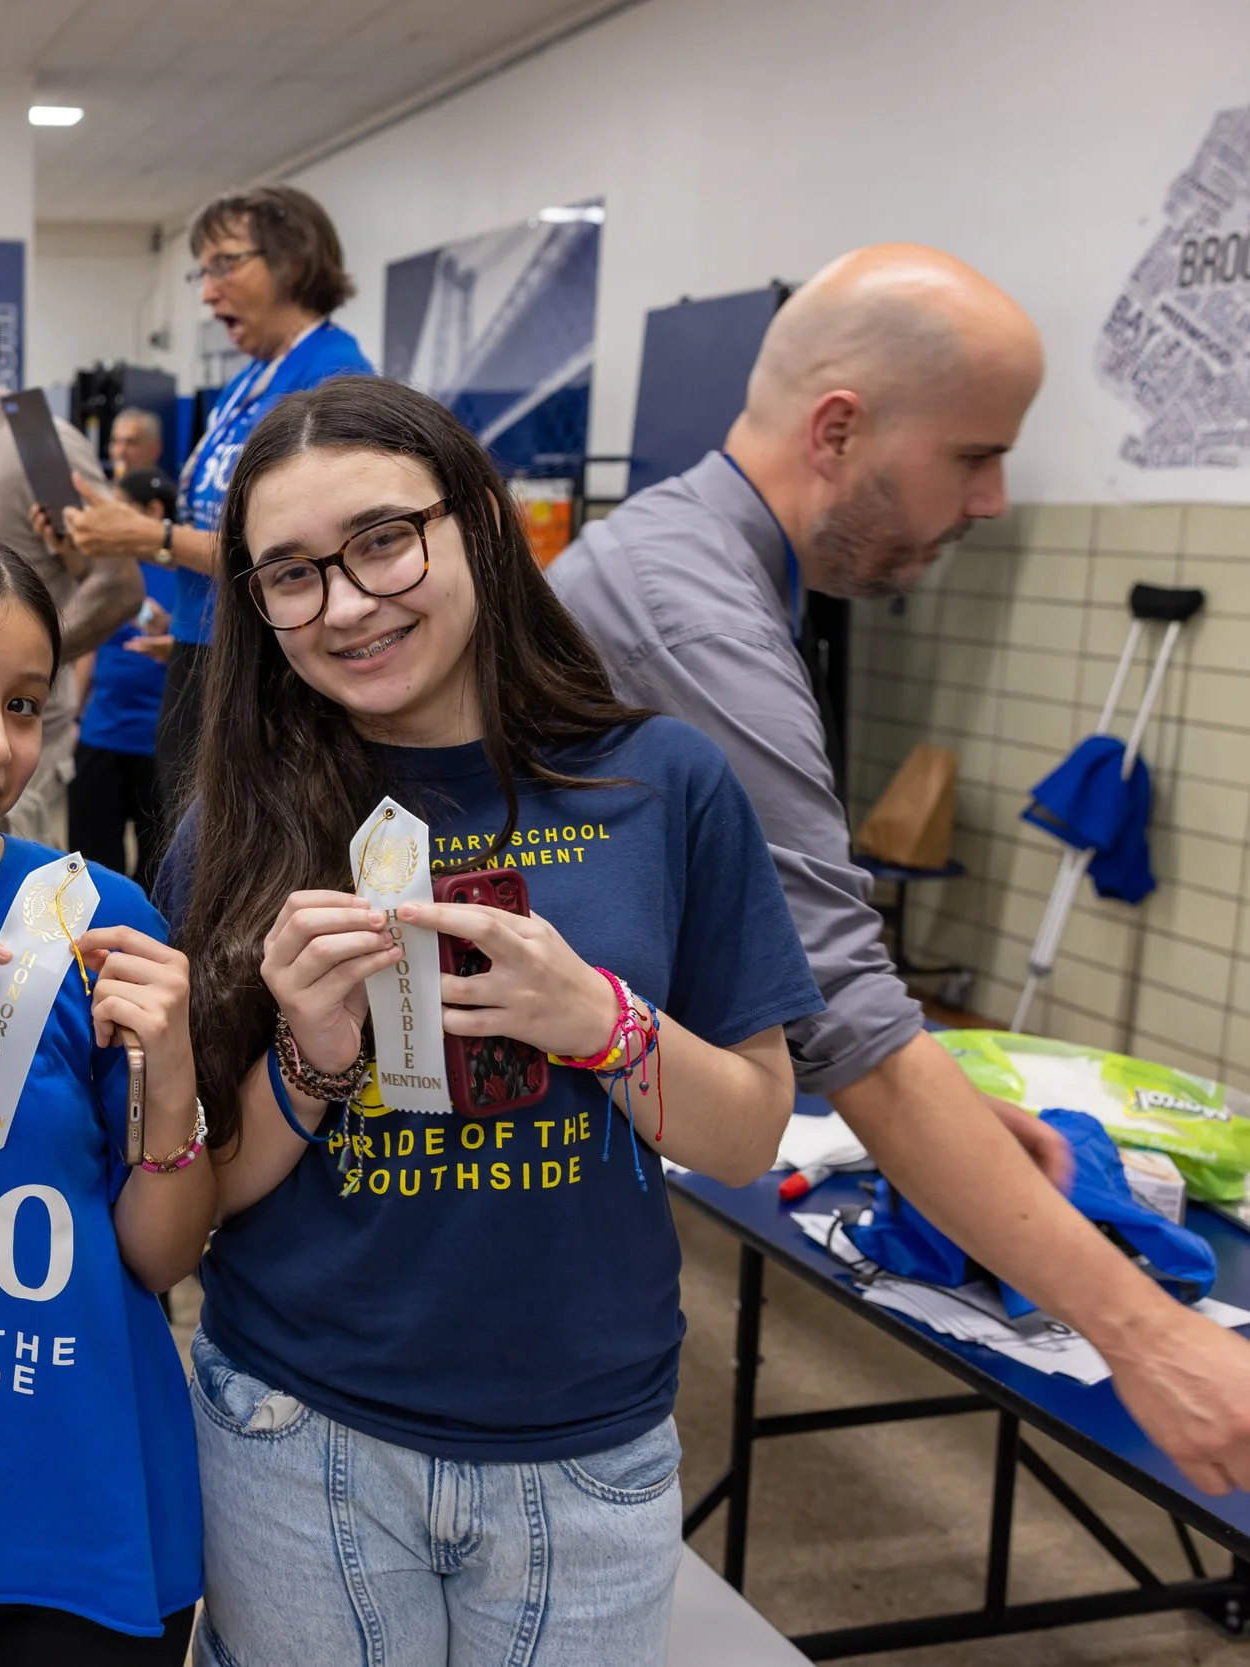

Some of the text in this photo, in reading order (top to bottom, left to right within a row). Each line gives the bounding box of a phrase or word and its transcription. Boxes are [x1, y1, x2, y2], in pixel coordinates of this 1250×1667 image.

[427, 824, 610, 853] TARY SCHOOL
[381, 1072, 442, 1090] MENTION
[328, 1112, 591, 1158] PRIDE OF THE
[343, 1155, 582, 1196] SOUTHSIDE
